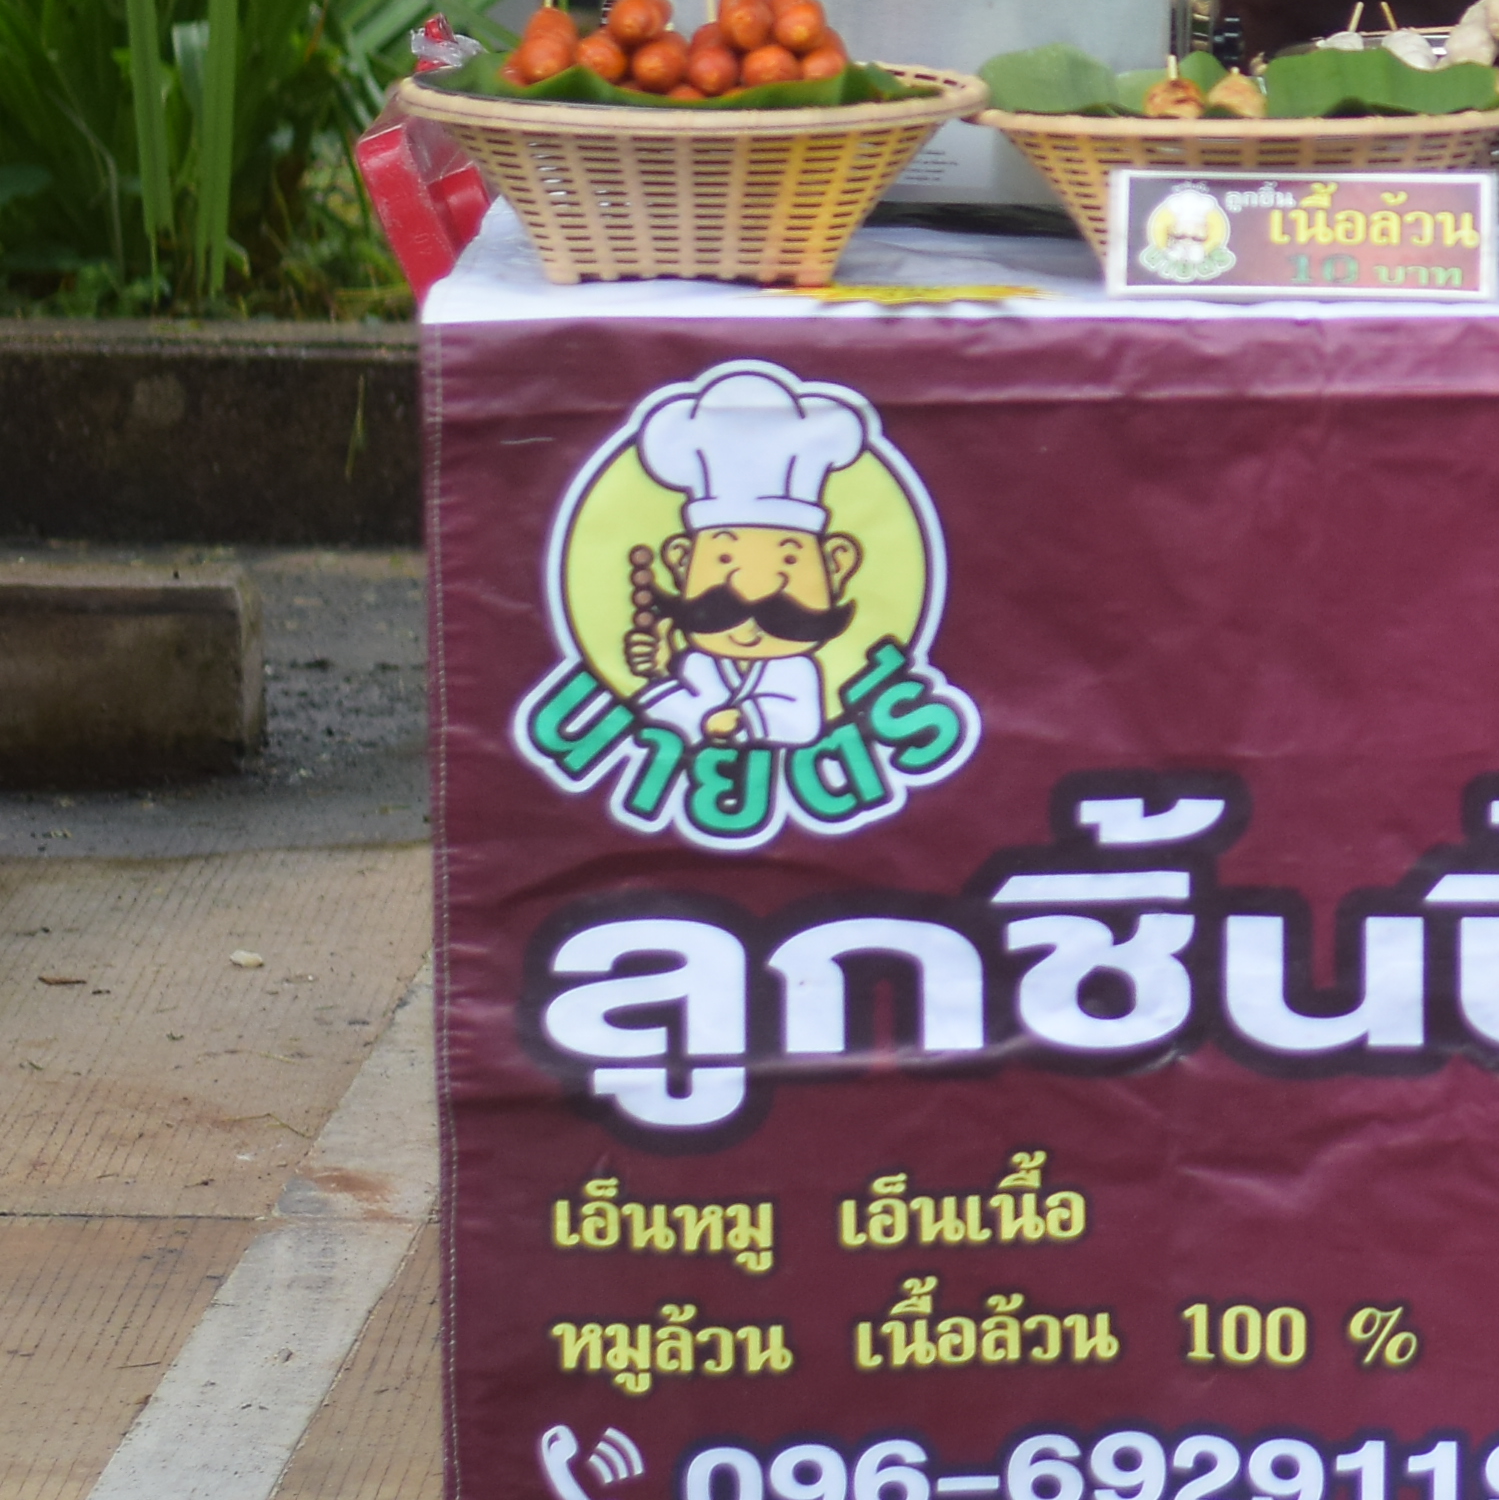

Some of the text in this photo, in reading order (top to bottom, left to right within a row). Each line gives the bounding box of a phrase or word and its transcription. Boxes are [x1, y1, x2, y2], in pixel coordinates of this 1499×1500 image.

[1269, 182, 1481, 248] เนื้อล้วน
[1287, 254, 1463, 288] 10 บาท
[552, 1149, 1086, 1273] เอ็นหมู เอ็นเนื้อ
[551, 1275, 1418, 1393] หมูล้วน เนื้อล้วน 100 %
